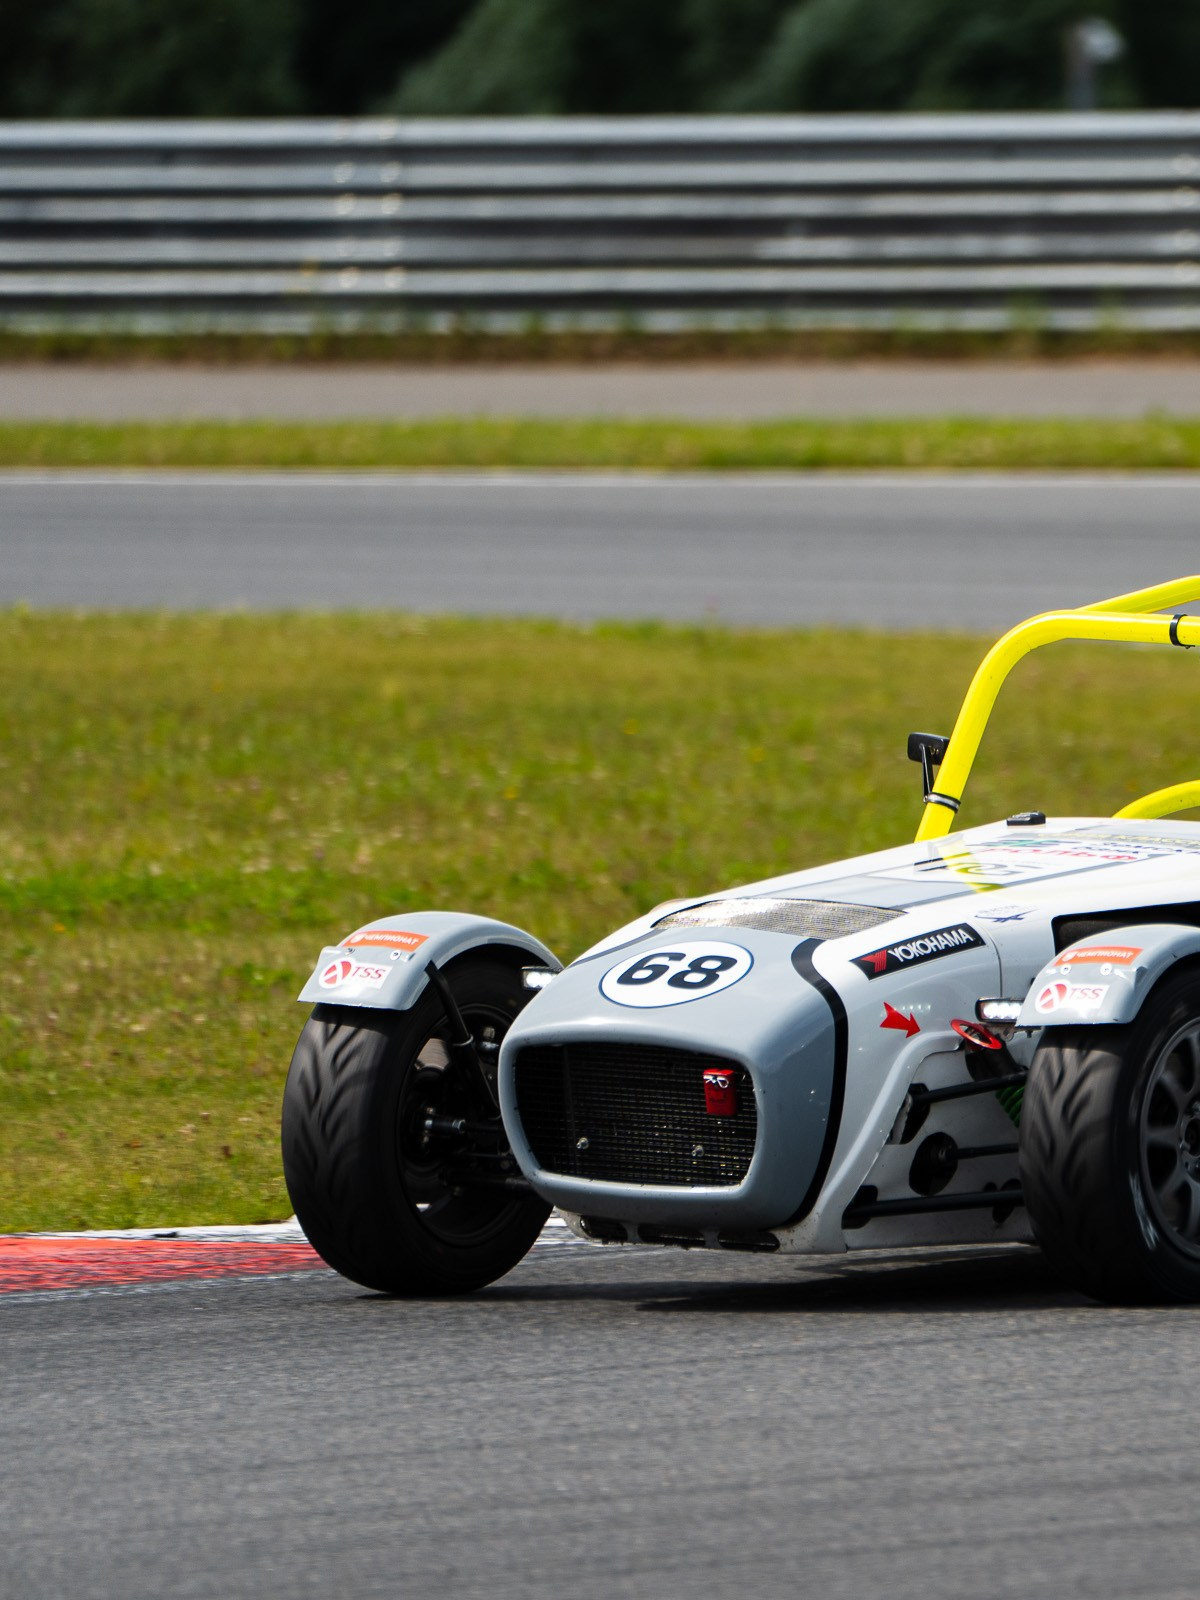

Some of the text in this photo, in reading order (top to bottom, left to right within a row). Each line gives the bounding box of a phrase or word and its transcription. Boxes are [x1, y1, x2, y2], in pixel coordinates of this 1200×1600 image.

[888, 929, 974, 962] YOKOHAMA
[1076, 949, 1135, 960] ЧЕМПИОНАТ
[351, 966, 386, 980] TSS
[616, 952, 738, 990] 68
[1069, 987, 1104, 1000] TSS
